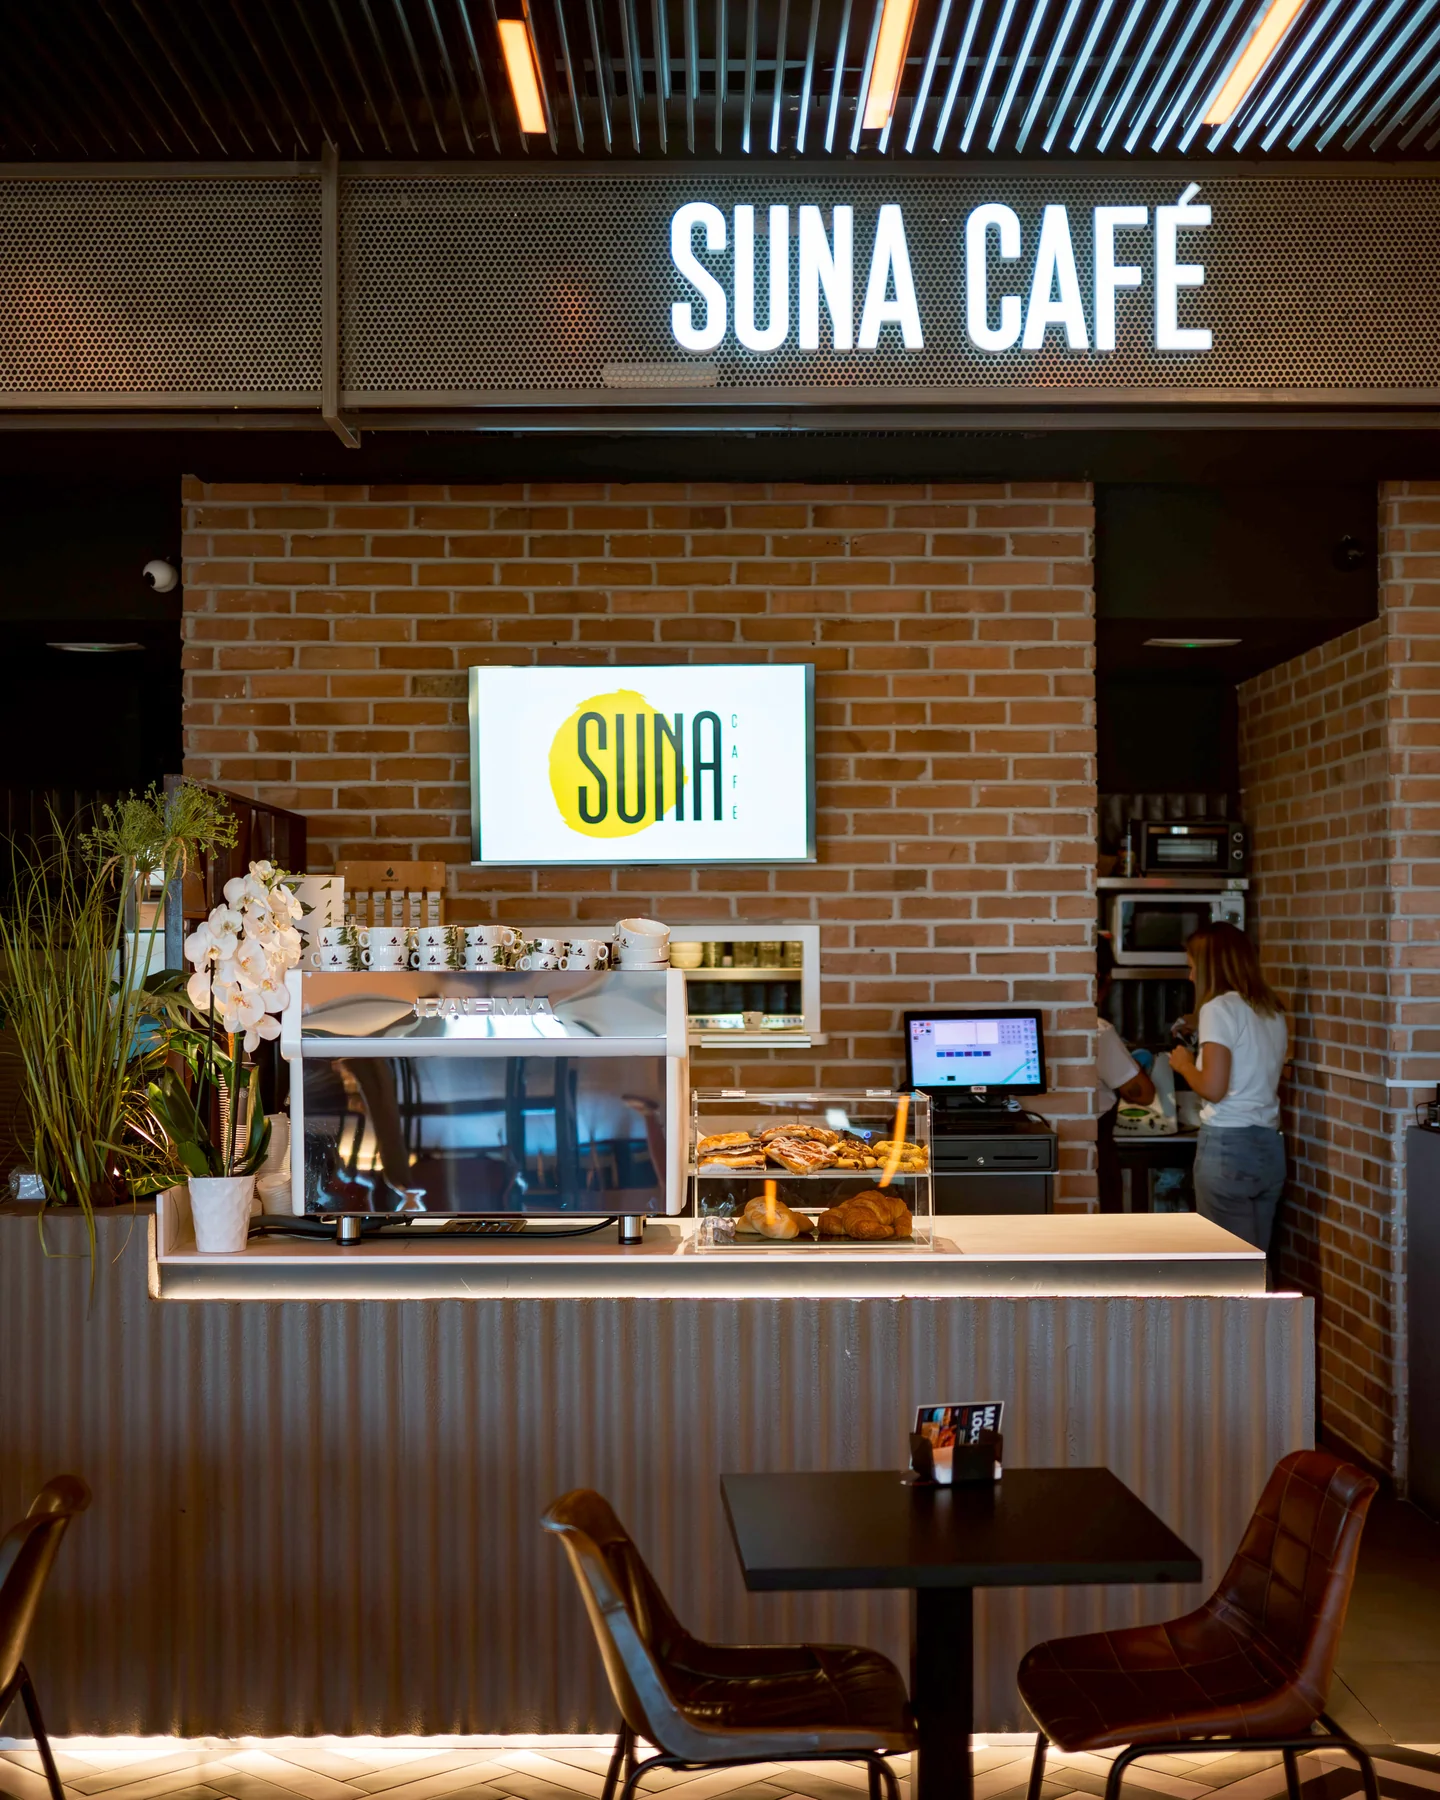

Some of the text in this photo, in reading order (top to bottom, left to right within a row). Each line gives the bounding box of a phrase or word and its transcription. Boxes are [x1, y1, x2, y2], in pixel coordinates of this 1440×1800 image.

[671, 181, 1213, 351] SUNA CAFÉ
[577, 711, 723, 824] SUNA
[414, 996, 554, 1016] FAEMA
